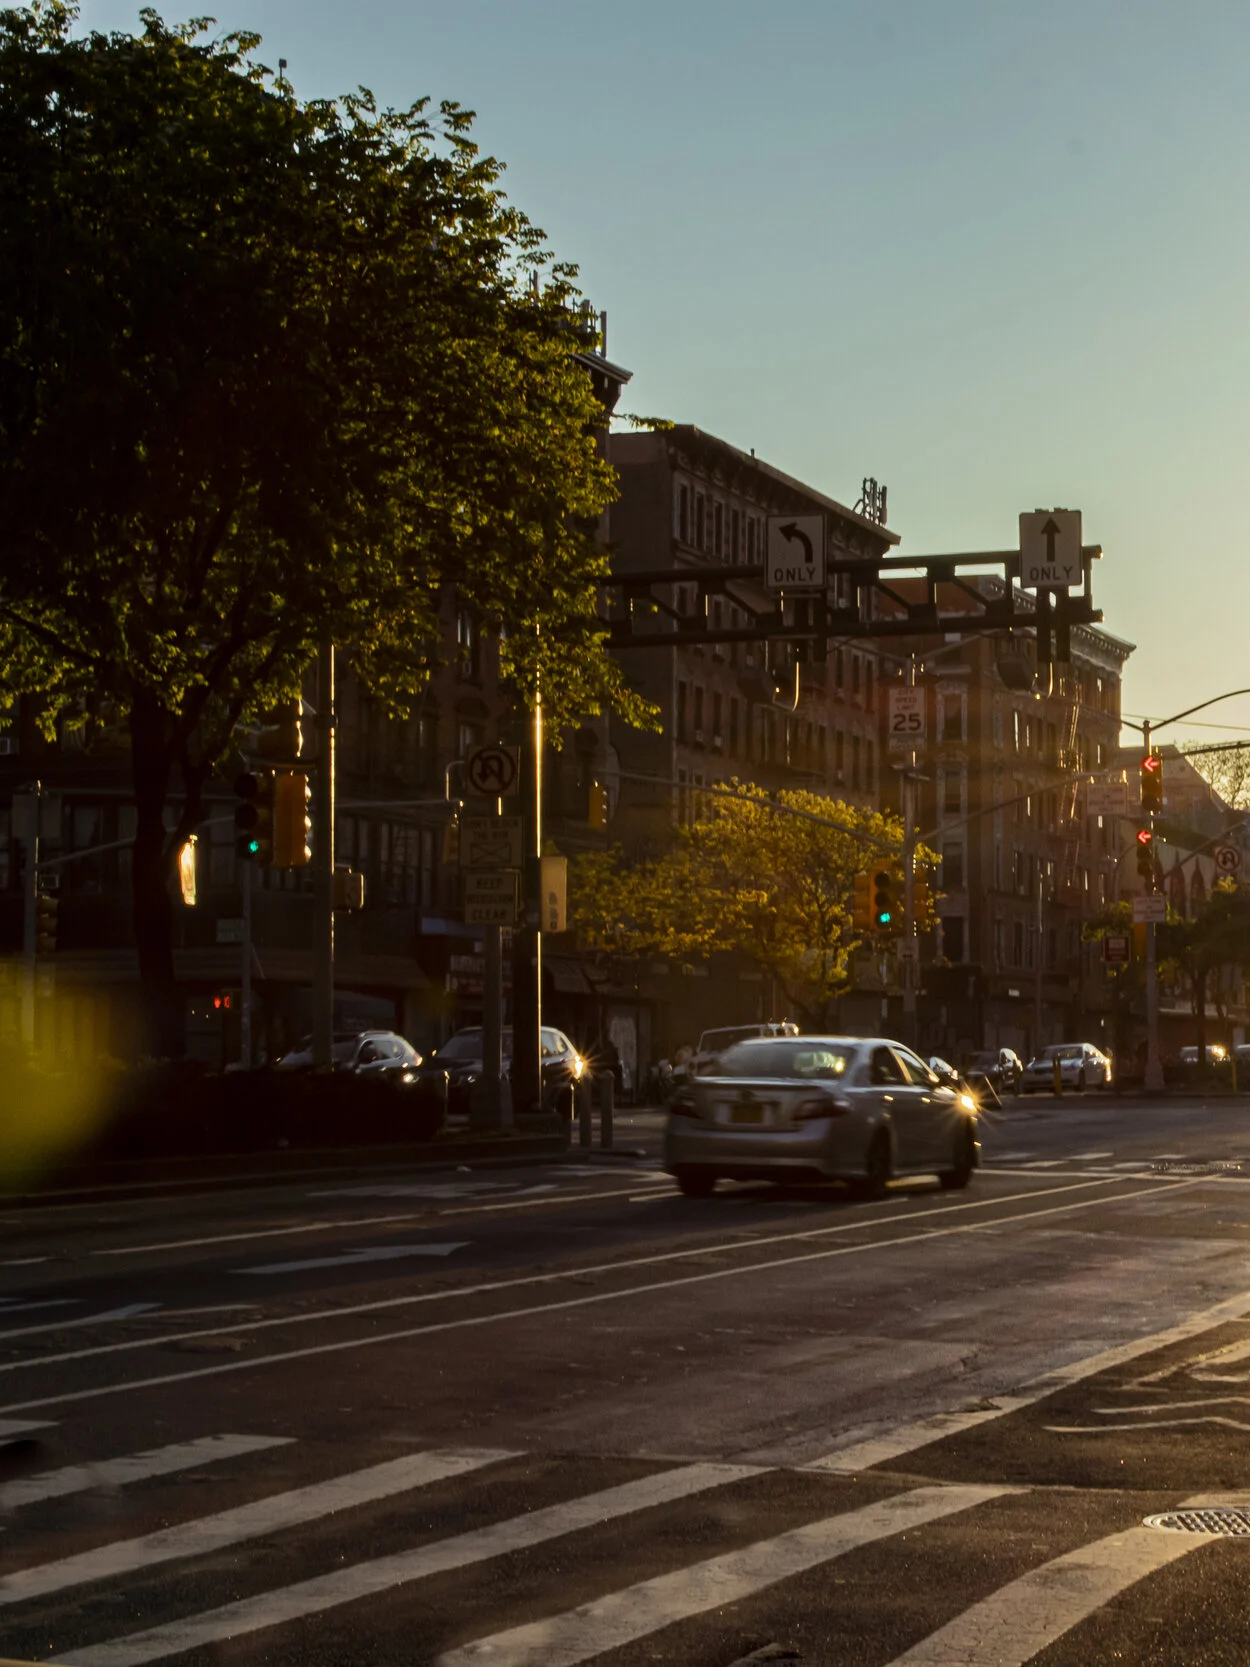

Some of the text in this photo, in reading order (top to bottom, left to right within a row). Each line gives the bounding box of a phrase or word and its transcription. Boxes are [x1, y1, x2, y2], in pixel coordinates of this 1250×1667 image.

[774, 567, 817, 582] ONLY
[1029, 565, 1074, 582] ONLY
[893, 713, 922, 731] 25
